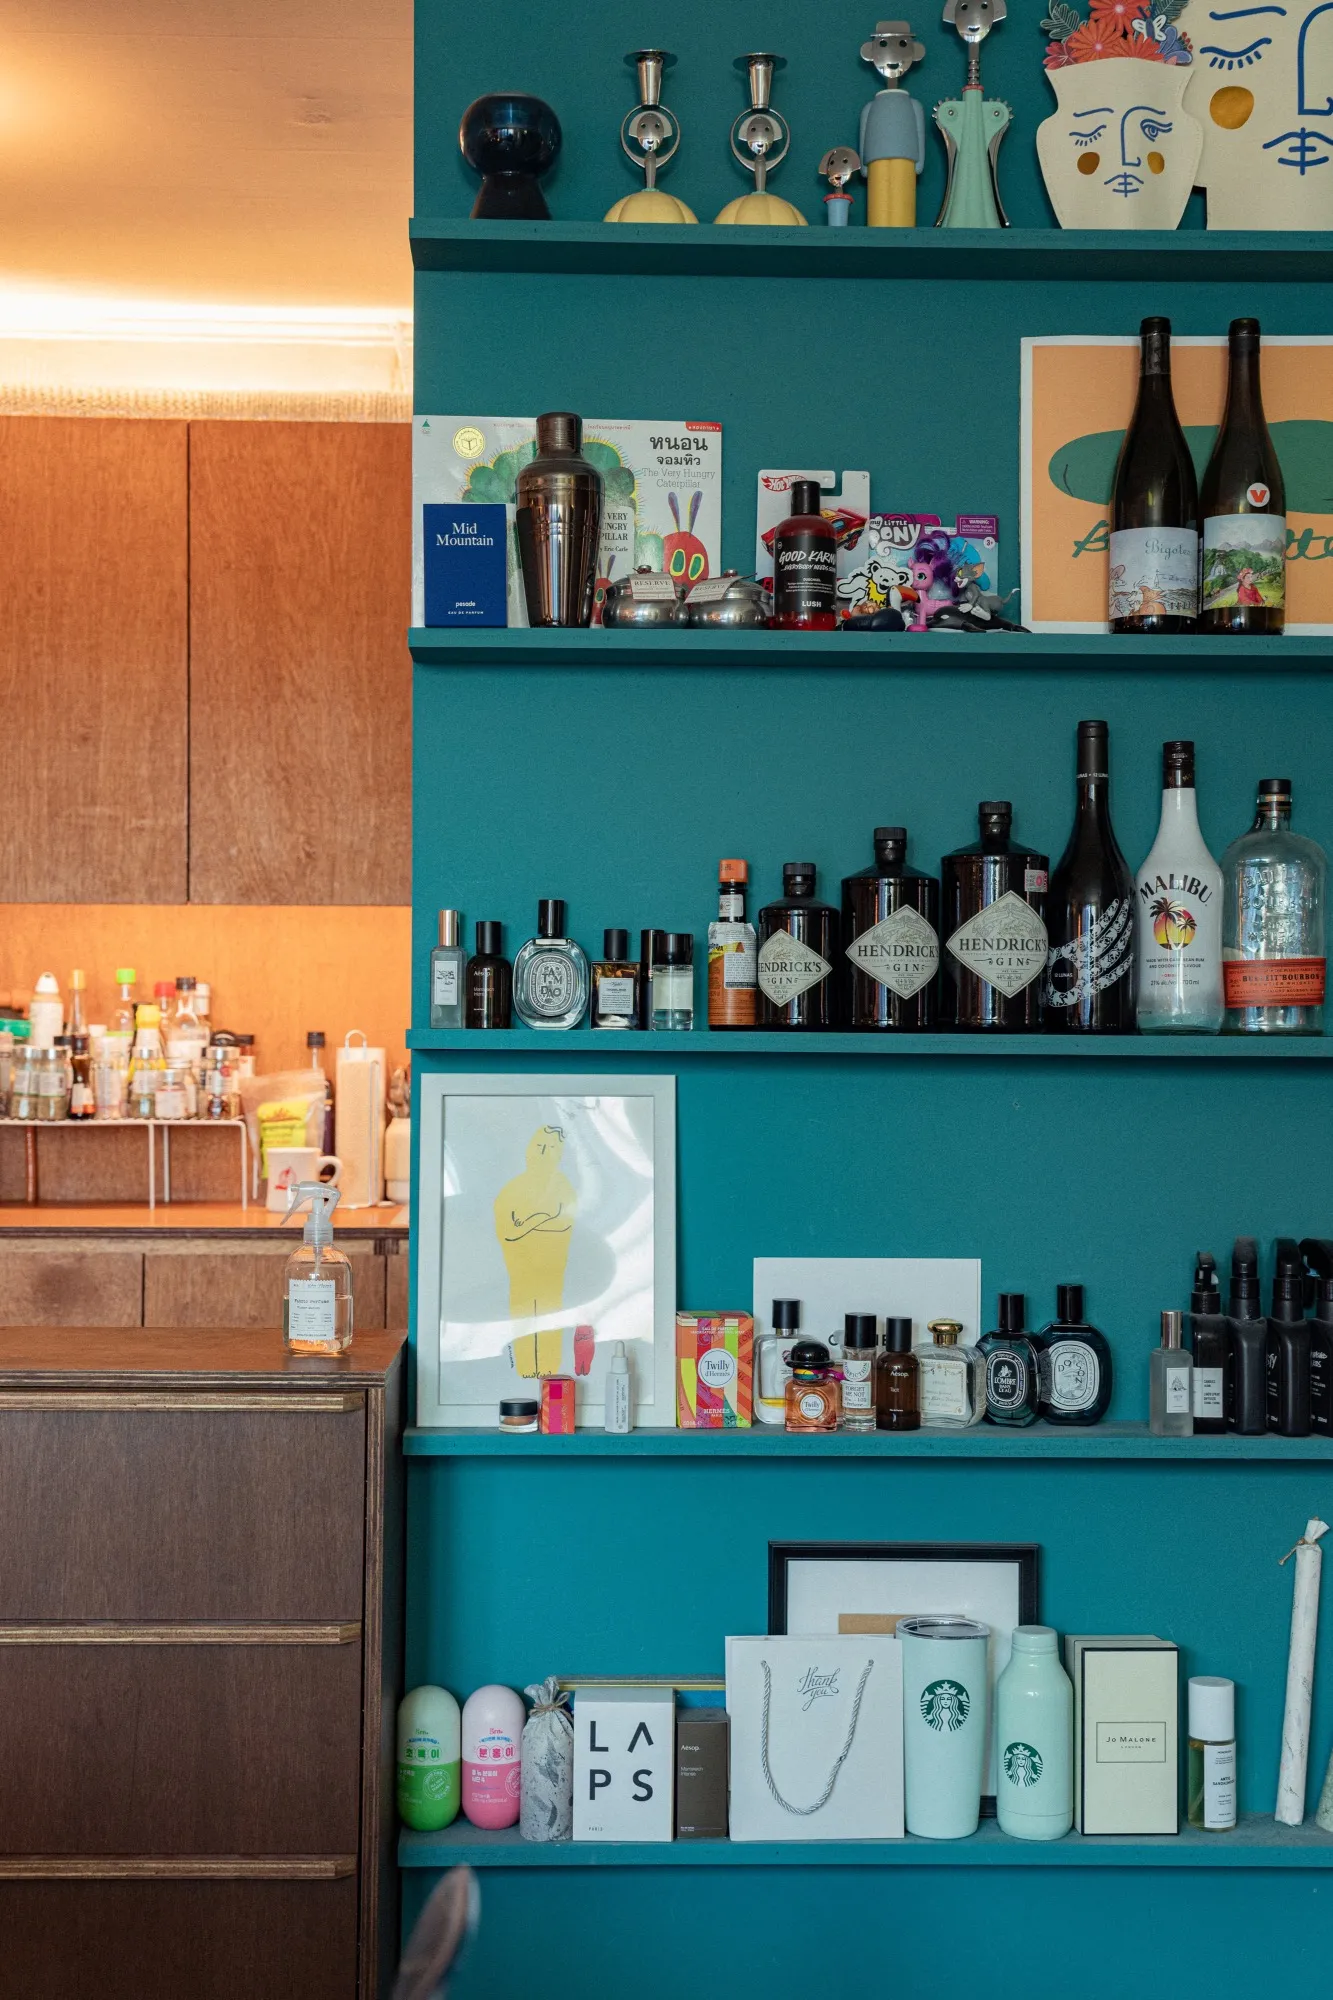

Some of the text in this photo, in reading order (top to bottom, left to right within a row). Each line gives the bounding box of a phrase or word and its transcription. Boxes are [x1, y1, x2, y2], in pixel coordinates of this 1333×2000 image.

[649, 436, 708, 451] หนอน
[656, 453, 701, 465] จอมหิว
[642, 468, 716, 479] The Very Hungry
[656, 479, 701, 489] Caterpillar
[1250, 490, 1267, 503] V
[452, 523, 478, 534] Mid
[436, 534, 493, 546] Mountain
[779, 550, 836, 565] GOOD KARM
[1140, 874, 1213, 904] MALIBU
[959, 938, 1047, 952] HENDRICK'S
[893, 963, 920, 971] GIN
[995, 957, 1024, 966] GIN
[541, 985, 562, 998] DAO
[705, 1360, 730, 1371] Twilly
[1058, 1360, 1072, 1372] DO
[1075, 1361, 1085, 1384] SON
[797, 1666, 841, 1693] Thank
[802, 1689, 829, 1711] you
